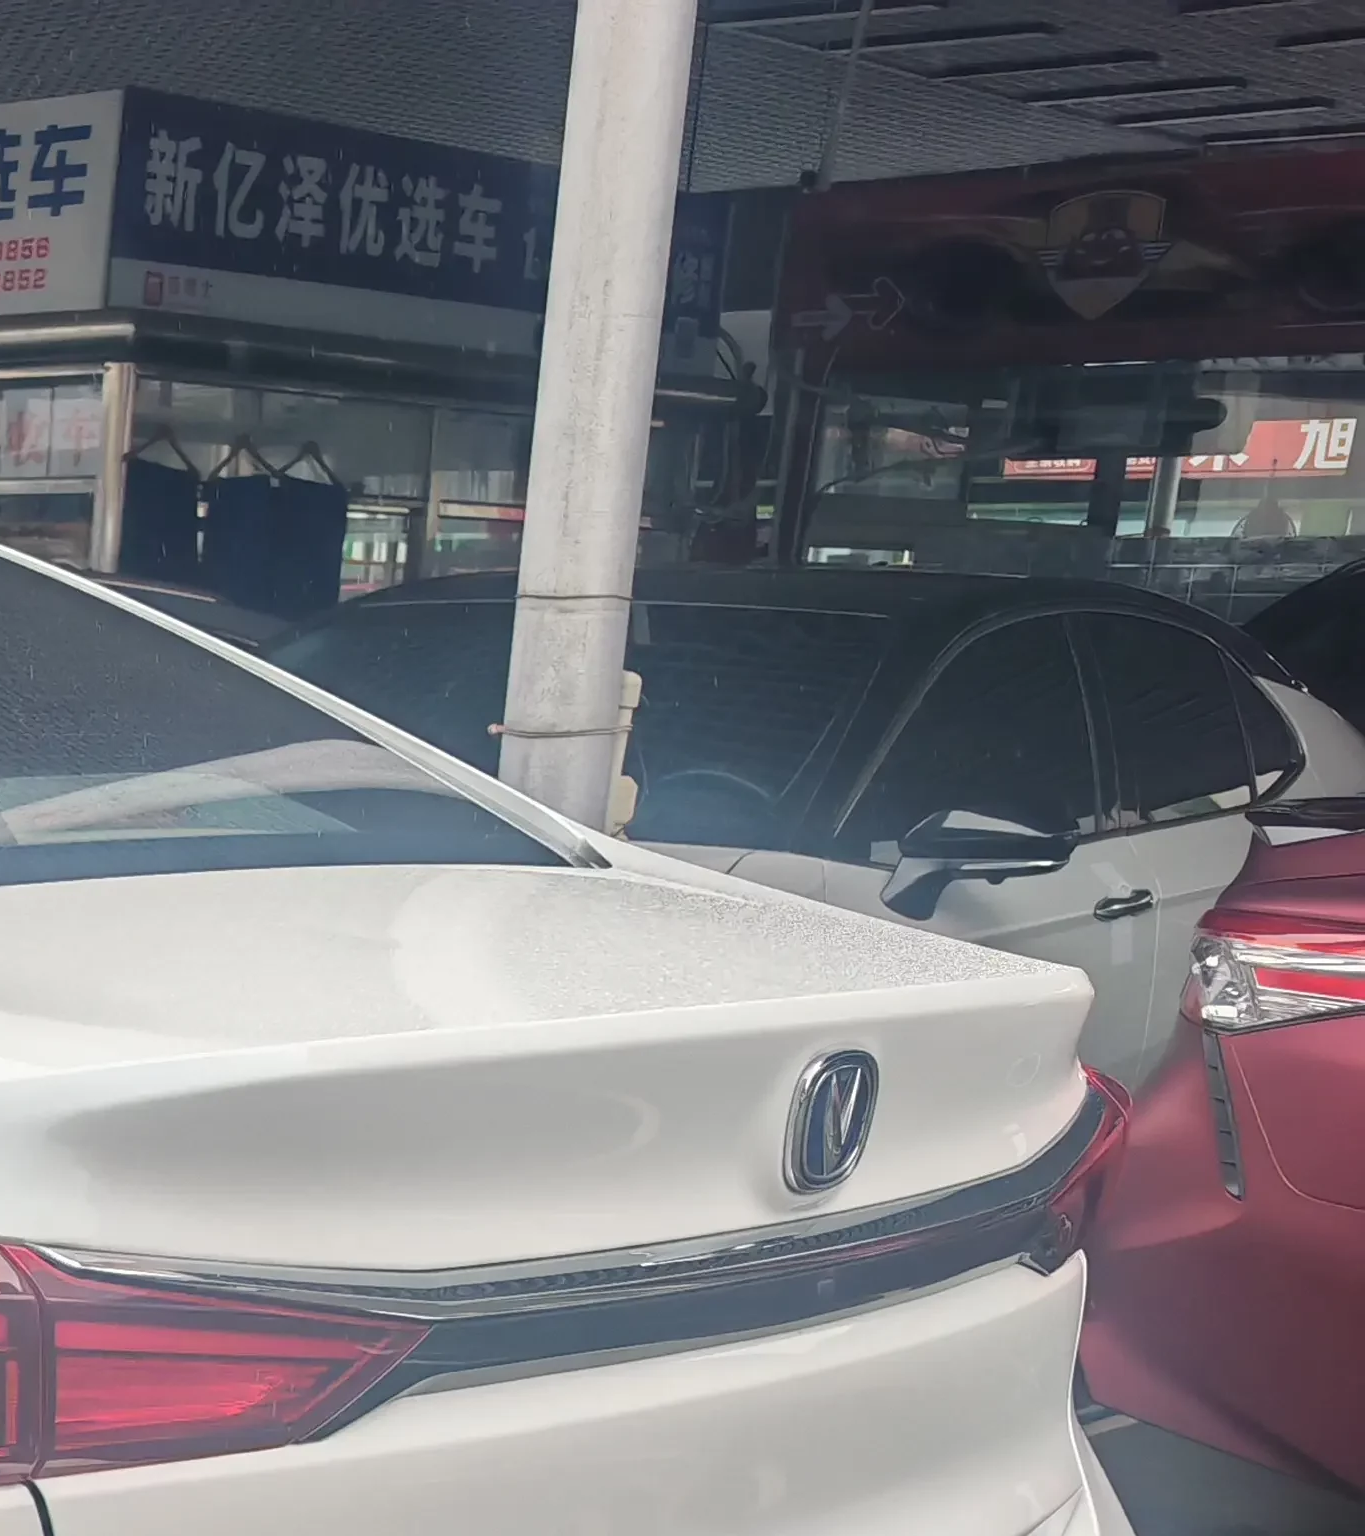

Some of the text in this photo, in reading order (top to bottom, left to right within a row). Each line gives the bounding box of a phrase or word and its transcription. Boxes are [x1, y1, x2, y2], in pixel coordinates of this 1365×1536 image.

[143, 128, 503, 273] 新亿泽优选车
